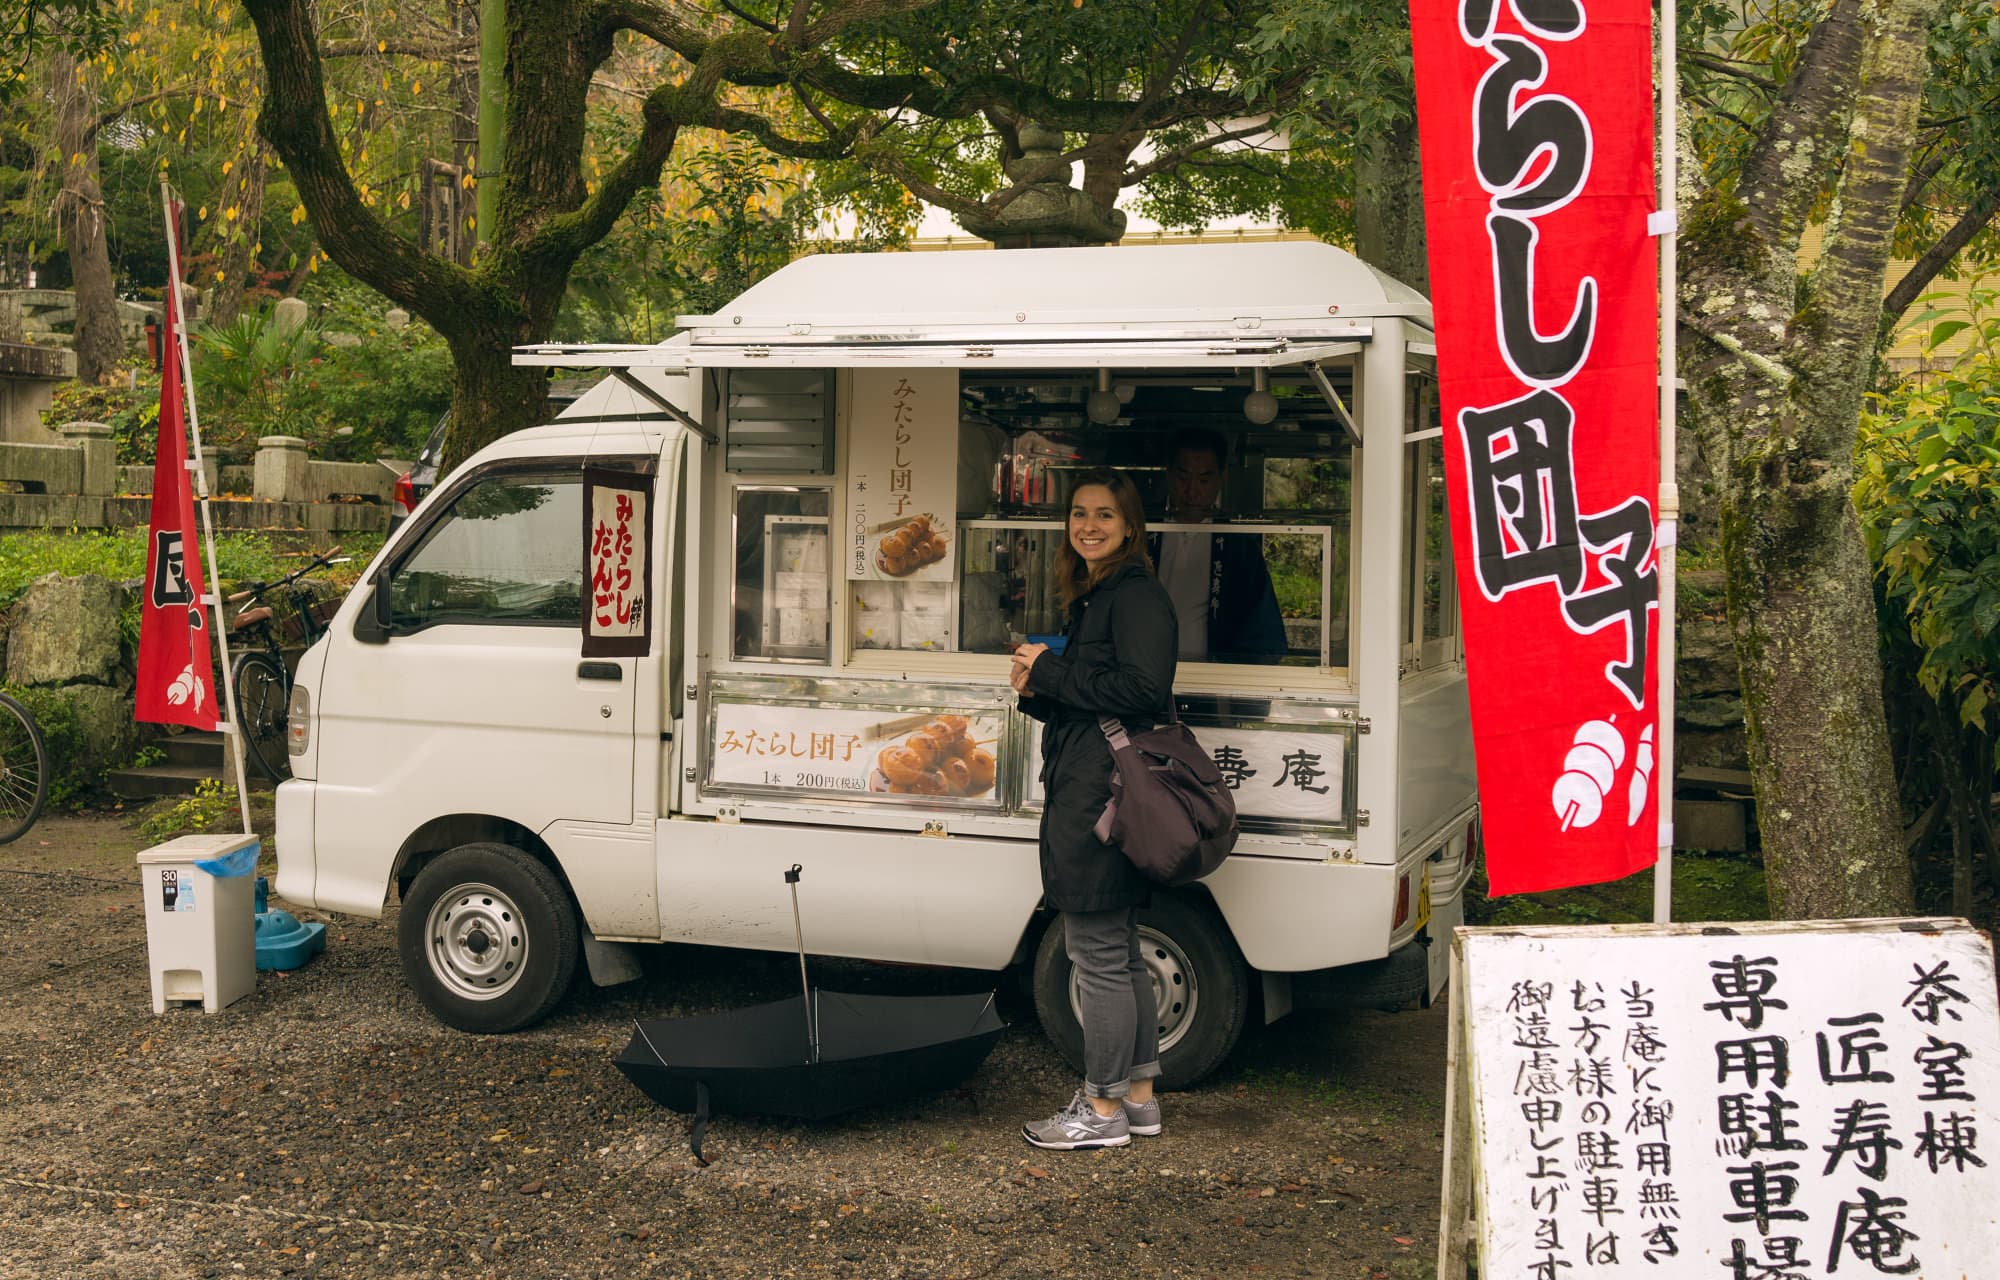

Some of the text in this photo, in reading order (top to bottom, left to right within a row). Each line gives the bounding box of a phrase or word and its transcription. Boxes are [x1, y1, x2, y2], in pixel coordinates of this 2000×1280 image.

[888, 377, 917, 517] みたらし団子
[592, 520, 615, 628] だんご
[615, 494, 633, 625] みたらし
[719, 729, 862, 762] みたらし団子
[763, 771, 781, 785] 1本
[162, 871, 176, 882] 30
[1901, 960, 1987, 1174] 茶室棟
[1816, 1012, 1921, 1275] 匠寿庵
